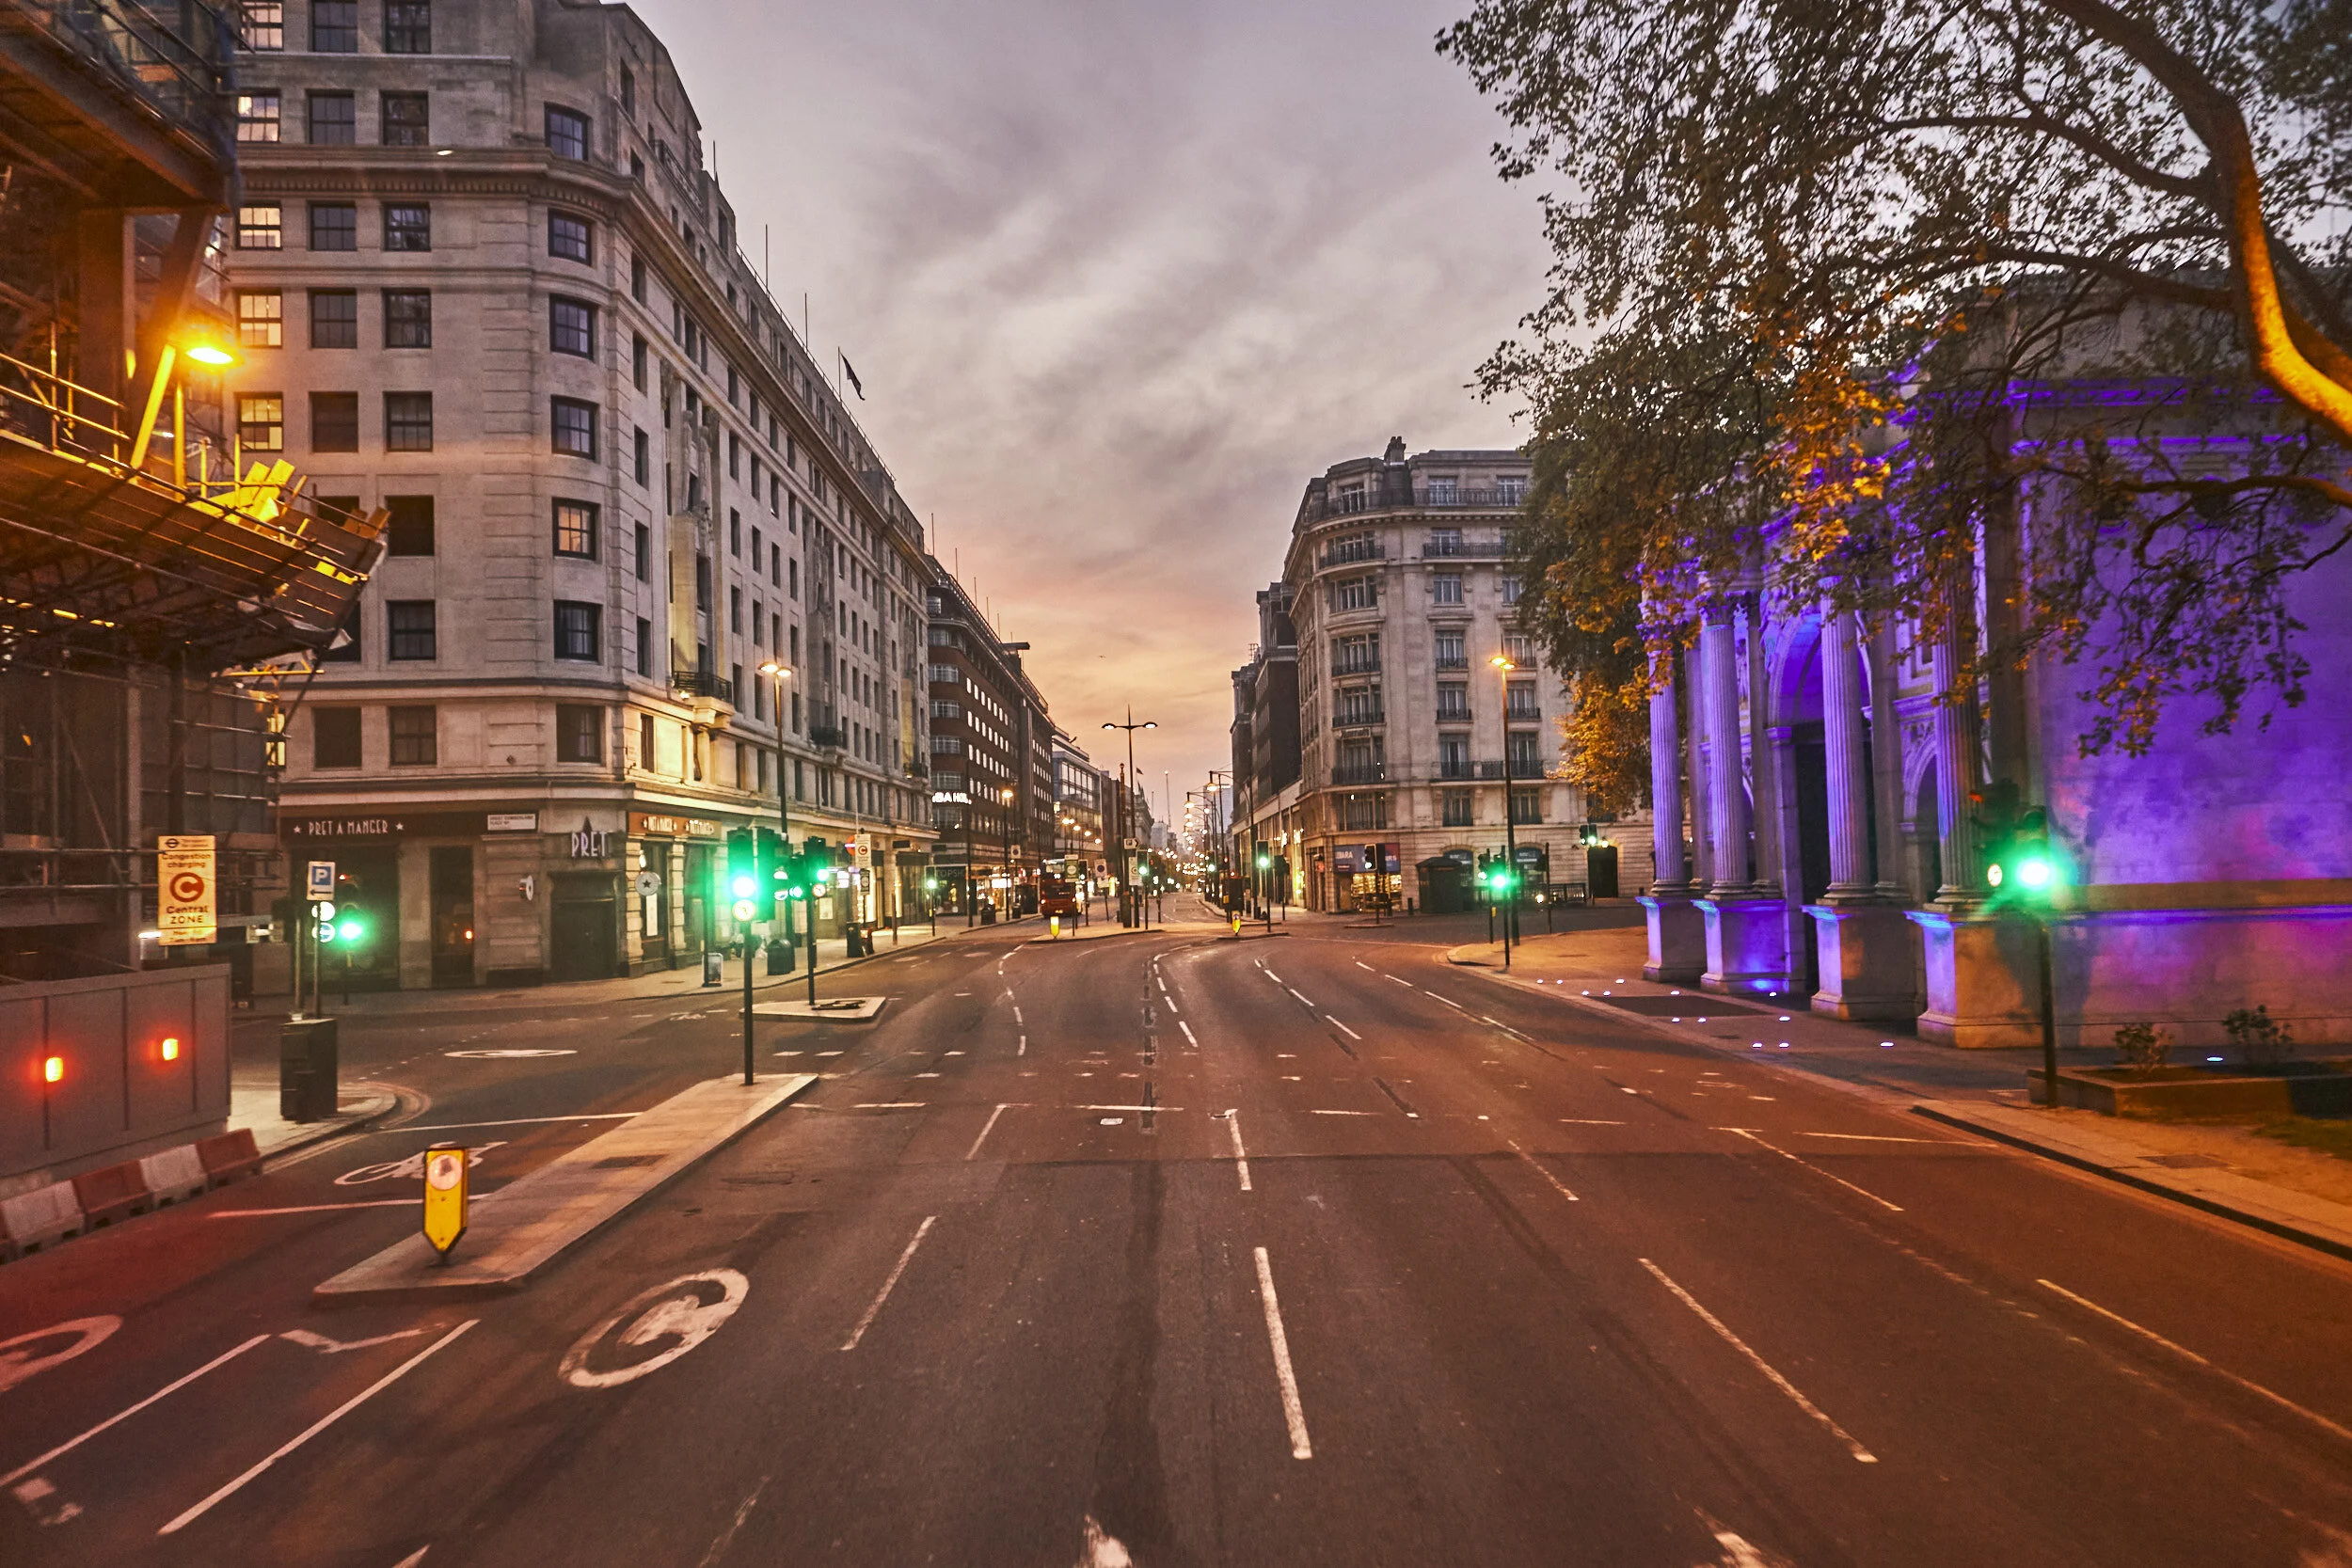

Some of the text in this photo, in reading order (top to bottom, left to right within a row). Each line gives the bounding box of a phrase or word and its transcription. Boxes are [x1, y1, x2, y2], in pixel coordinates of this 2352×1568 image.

[309, 819, 389, 836] PRET A MANGER
[571, 831, 610, 858] PRET
[167, 905, 209, 914] Central
[170, 915, 204, 925] ZONE
